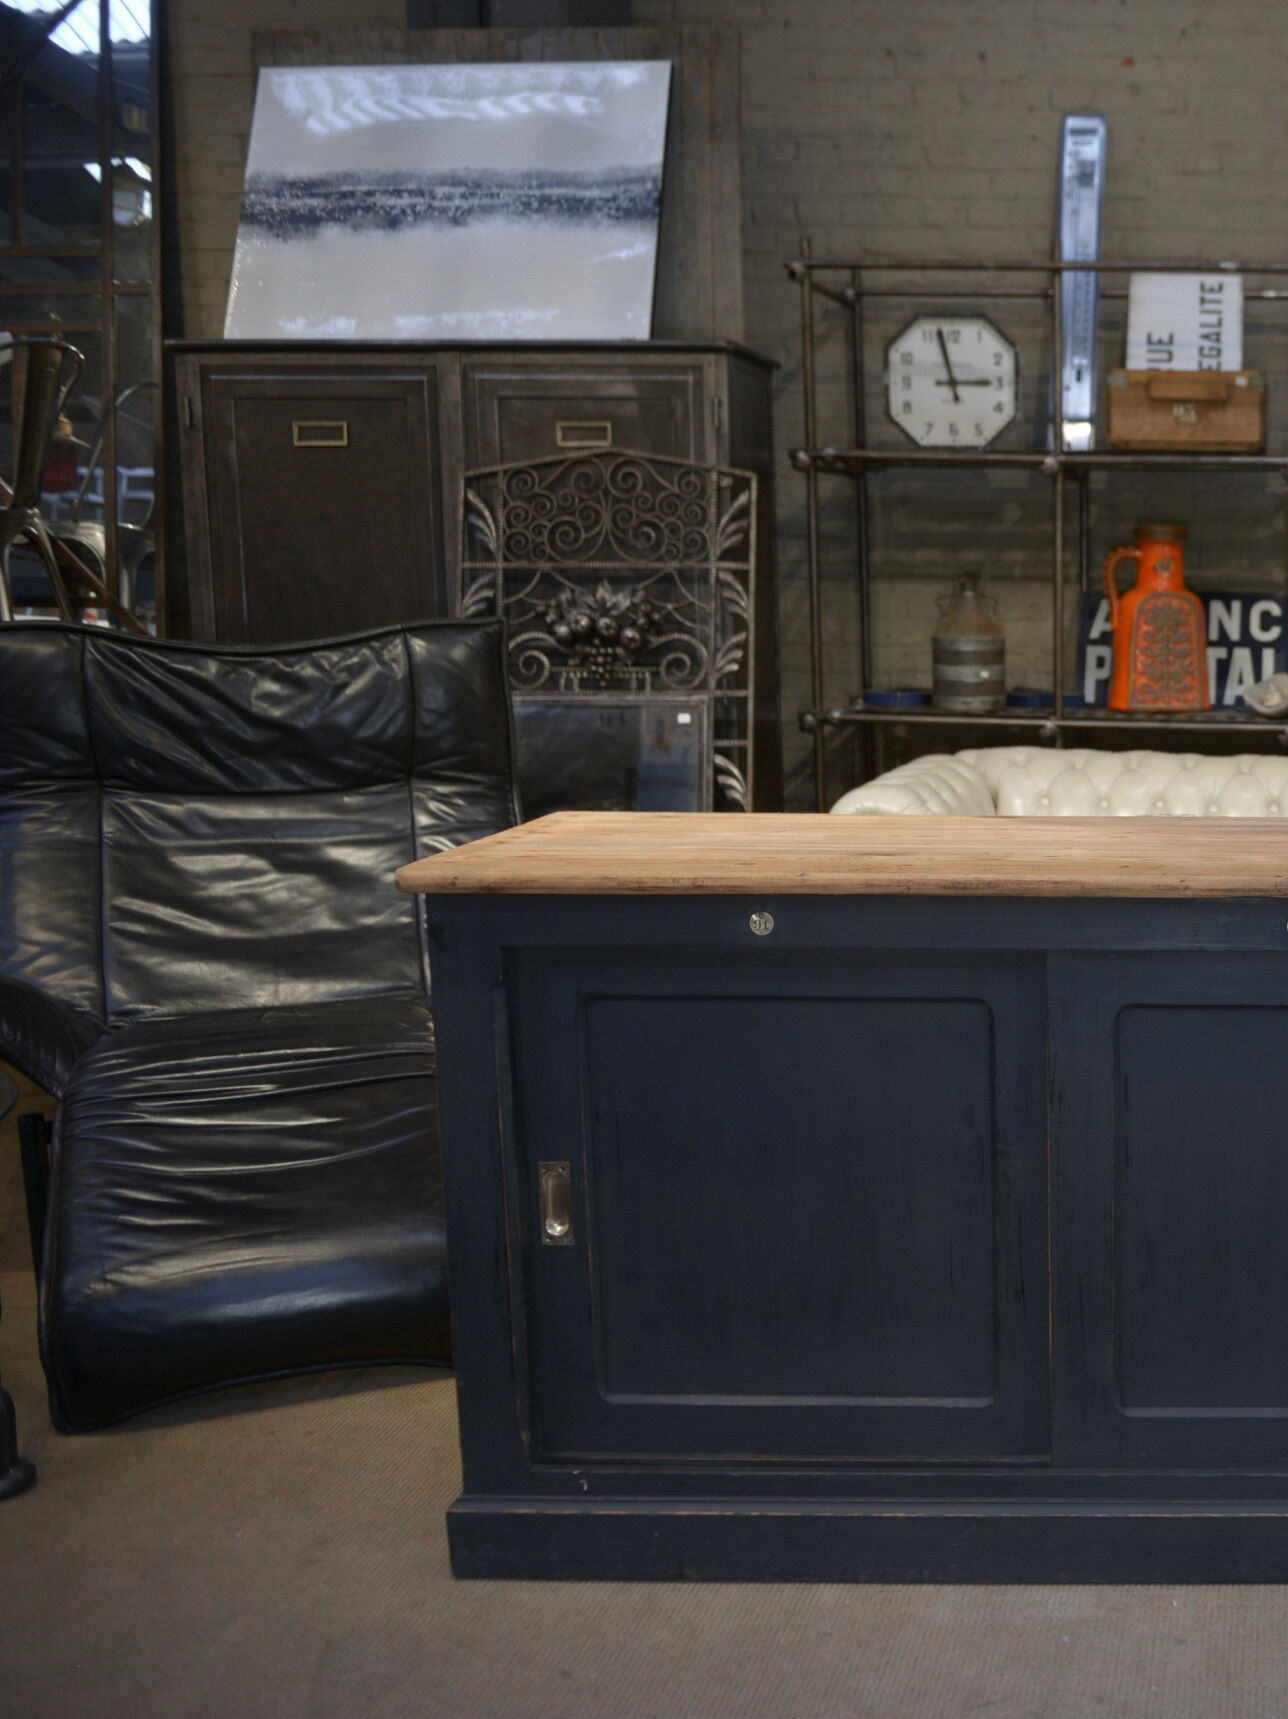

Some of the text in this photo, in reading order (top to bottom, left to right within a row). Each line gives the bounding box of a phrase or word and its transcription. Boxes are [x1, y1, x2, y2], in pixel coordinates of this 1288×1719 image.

[1146, 333, 1174, 371] UE
[925, 421, 934, 436] 7
[948, 421, 959, 437] 6
[974, 421, 984, 437] 5
